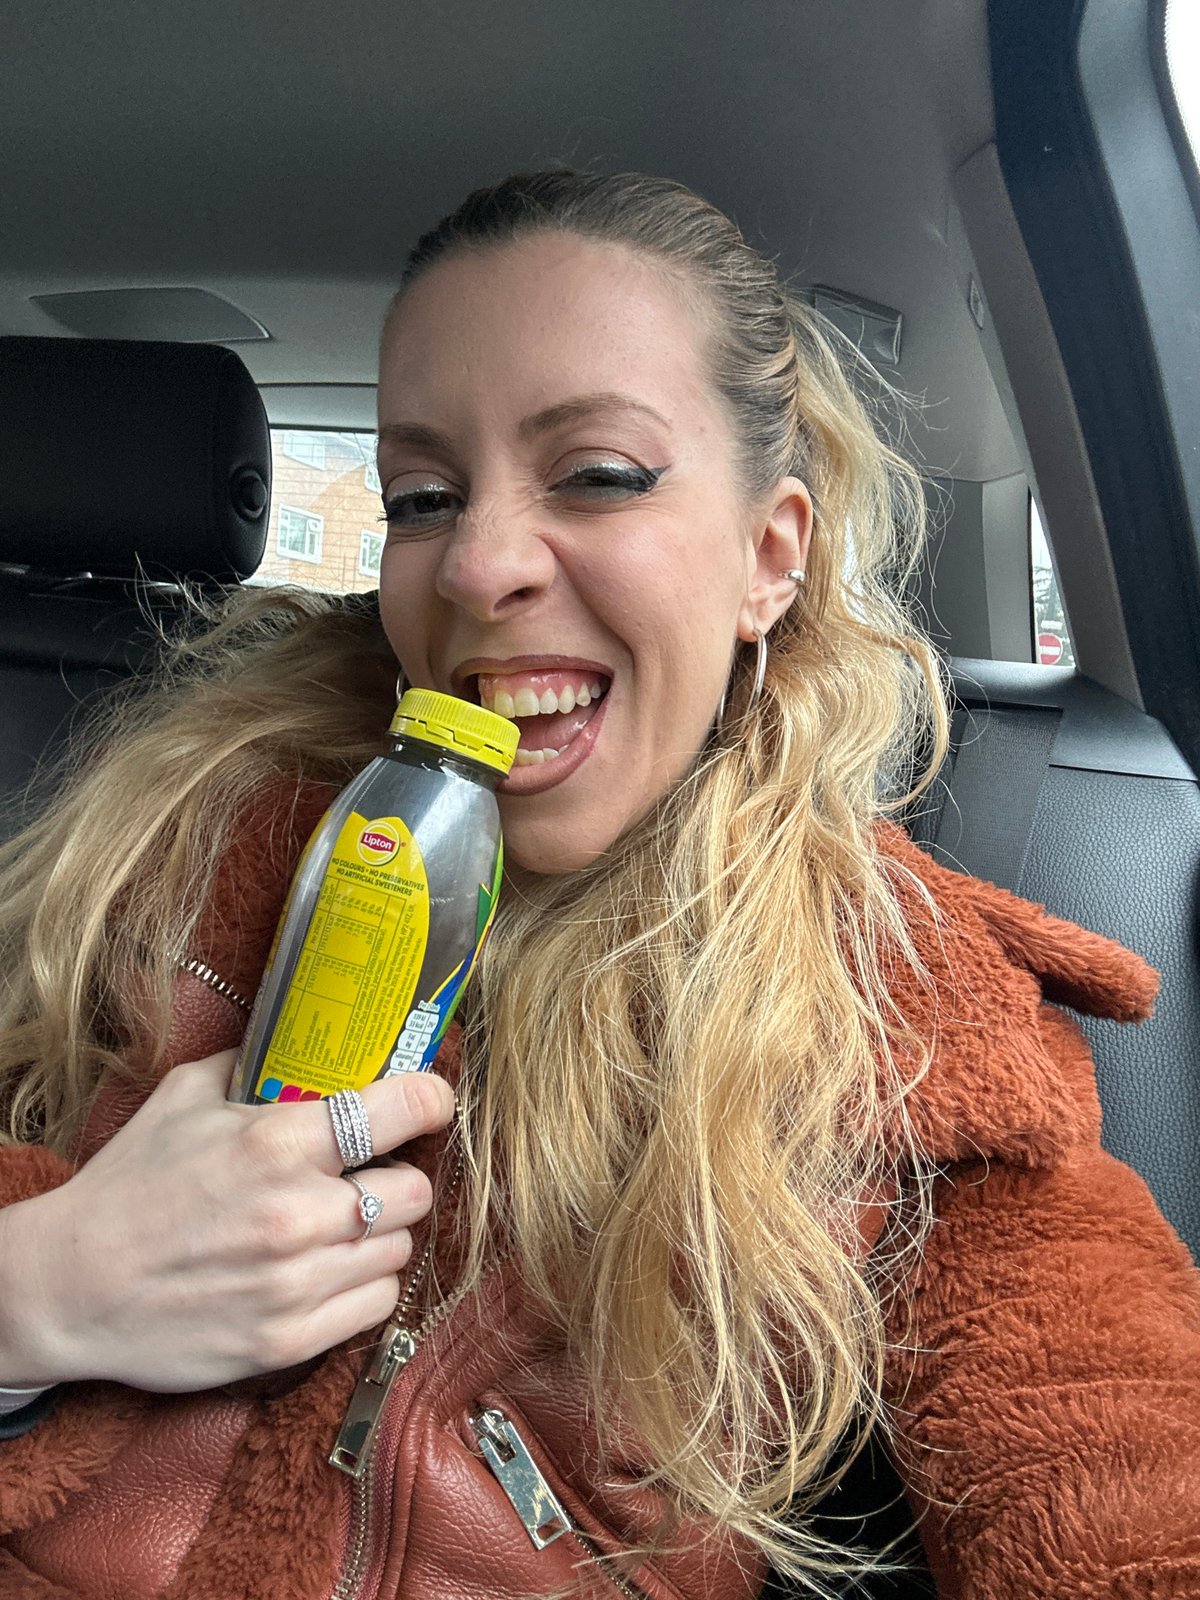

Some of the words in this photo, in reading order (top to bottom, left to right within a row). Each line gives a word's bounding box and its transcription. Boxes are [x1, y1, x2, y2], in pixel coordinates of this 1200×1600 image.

[363, 834, 392, 850] Lipton
[336, 868, 345, 876] NO
[345, 870, 374, 886] ARTIFICIAL
[375, 878, 413, 896] SWEETENERS
[339, 860, 365, 873] COLOURS
[369, 868, 379, 877] NO
[379, 870, 425, 891] PRESERVATIVES
[286, 1037, 296, 1054] Energy
